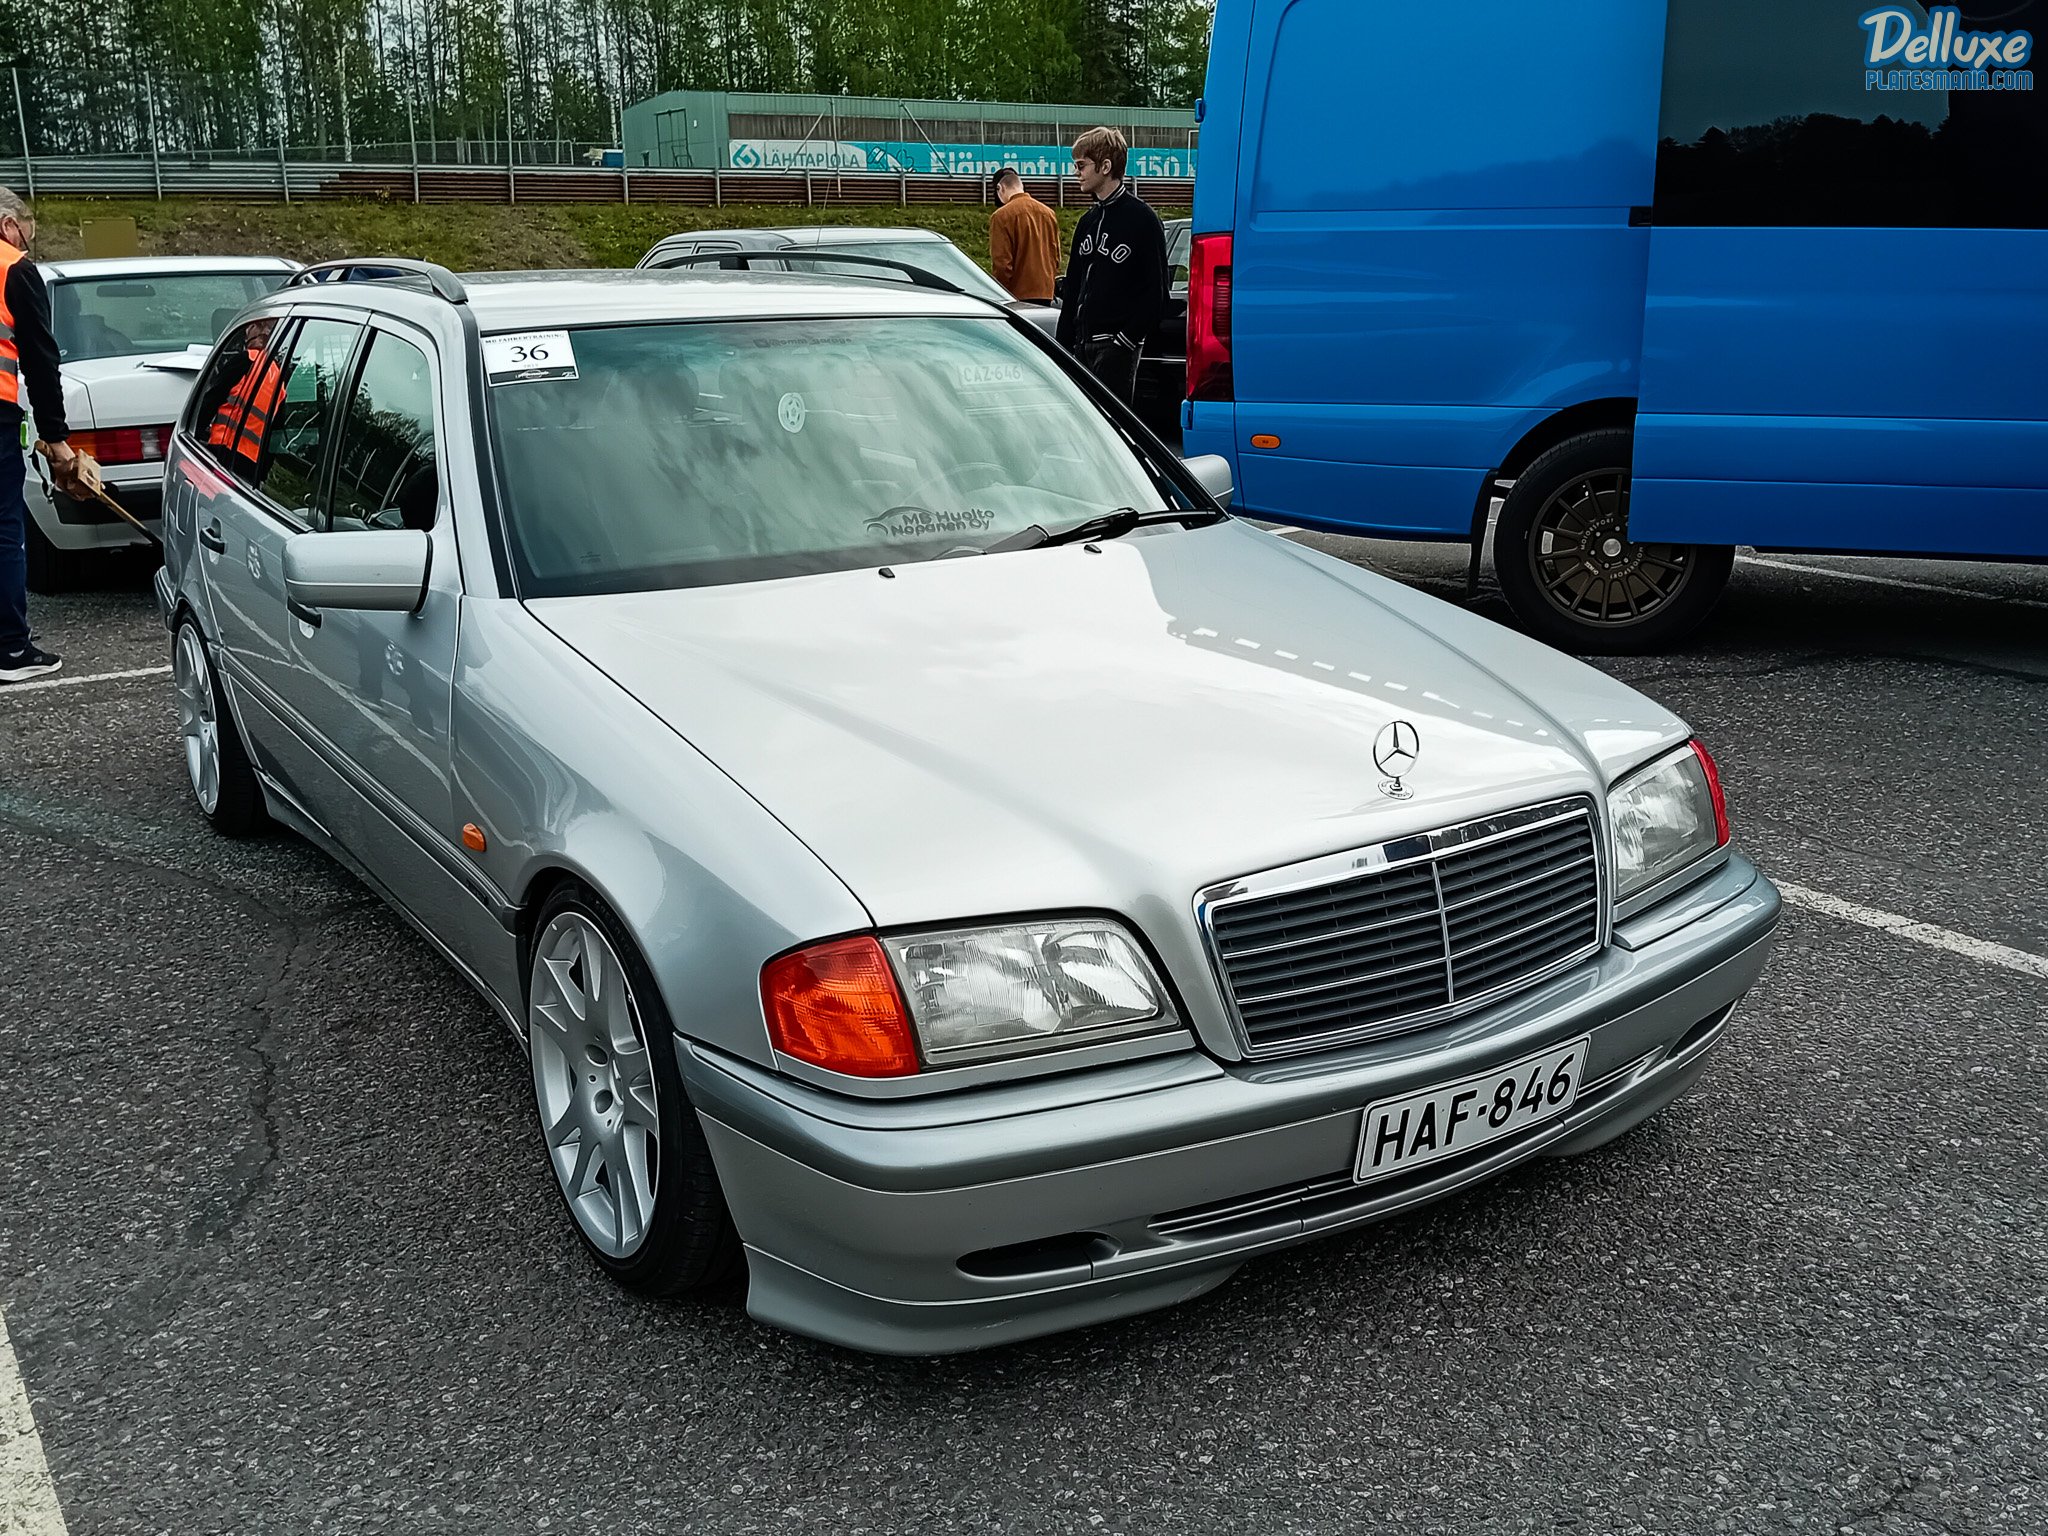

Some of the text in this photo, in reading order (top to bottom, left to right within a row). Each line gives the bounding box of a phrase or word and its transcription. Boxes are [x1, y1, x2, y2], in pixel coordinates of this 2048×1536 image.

[764, 149, 860, 168] LÄHITAPIOLA
[1136, 155, 1180, 177] 150
[1079, 233, 1131, 263] OLO
[510, 344, 549, 363] 36
[963, 365, 1021, 382] CAZ-646
[935, 508, 994, 523] Huolto
[969, 518, 990, 531] Oy
[1371, 1052, 1576, 1168] HAF-846
